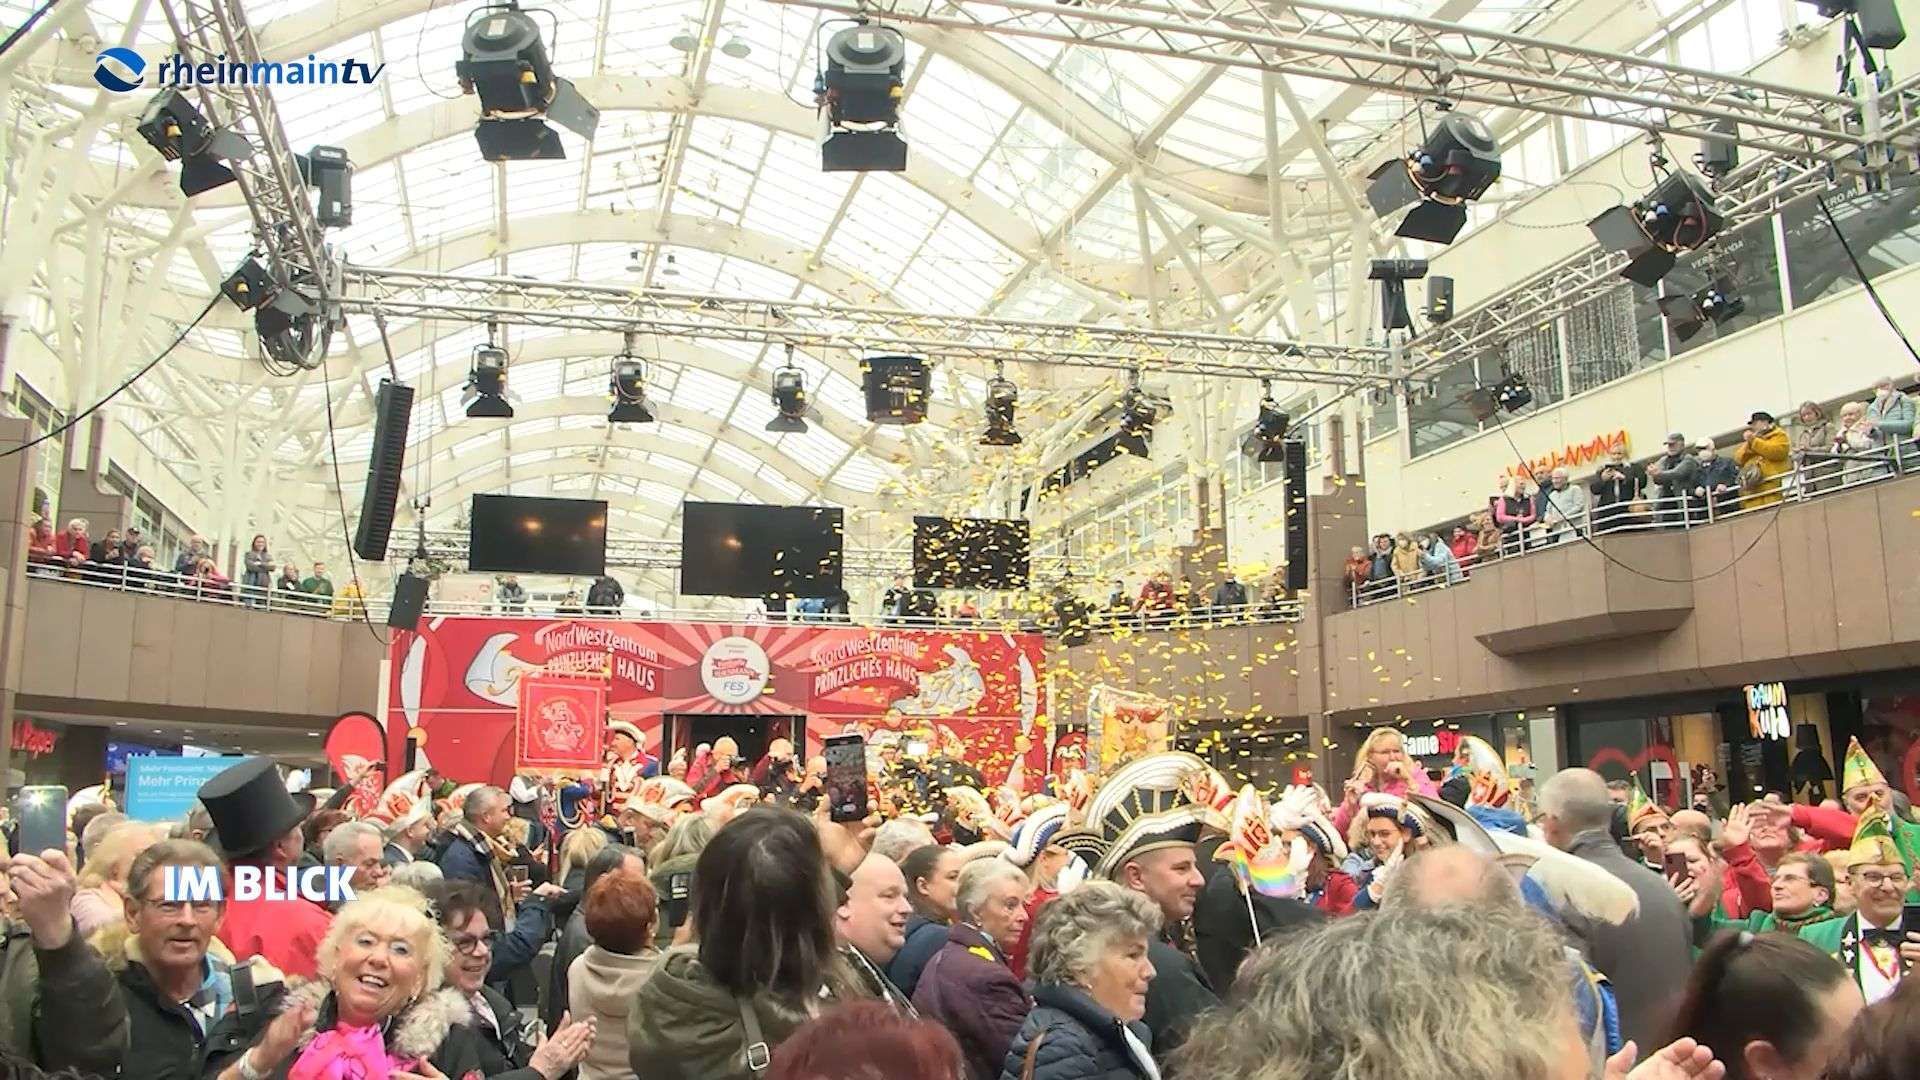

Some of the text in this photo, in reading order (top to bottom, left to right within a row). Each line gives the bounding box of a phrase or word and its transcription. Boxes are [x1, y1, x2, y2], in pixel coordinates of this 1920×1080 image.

[545, 624, 658, 663] NordWestZentrum
[547, 651, 656, 692] PRINZLICHE HAUS
[886, 659, 917, 685] HAUS
[724, 680, 745, 690] FES
[1401, 729, 1462, 756] GameSt
[138, 775, 171, 787] Mehr
